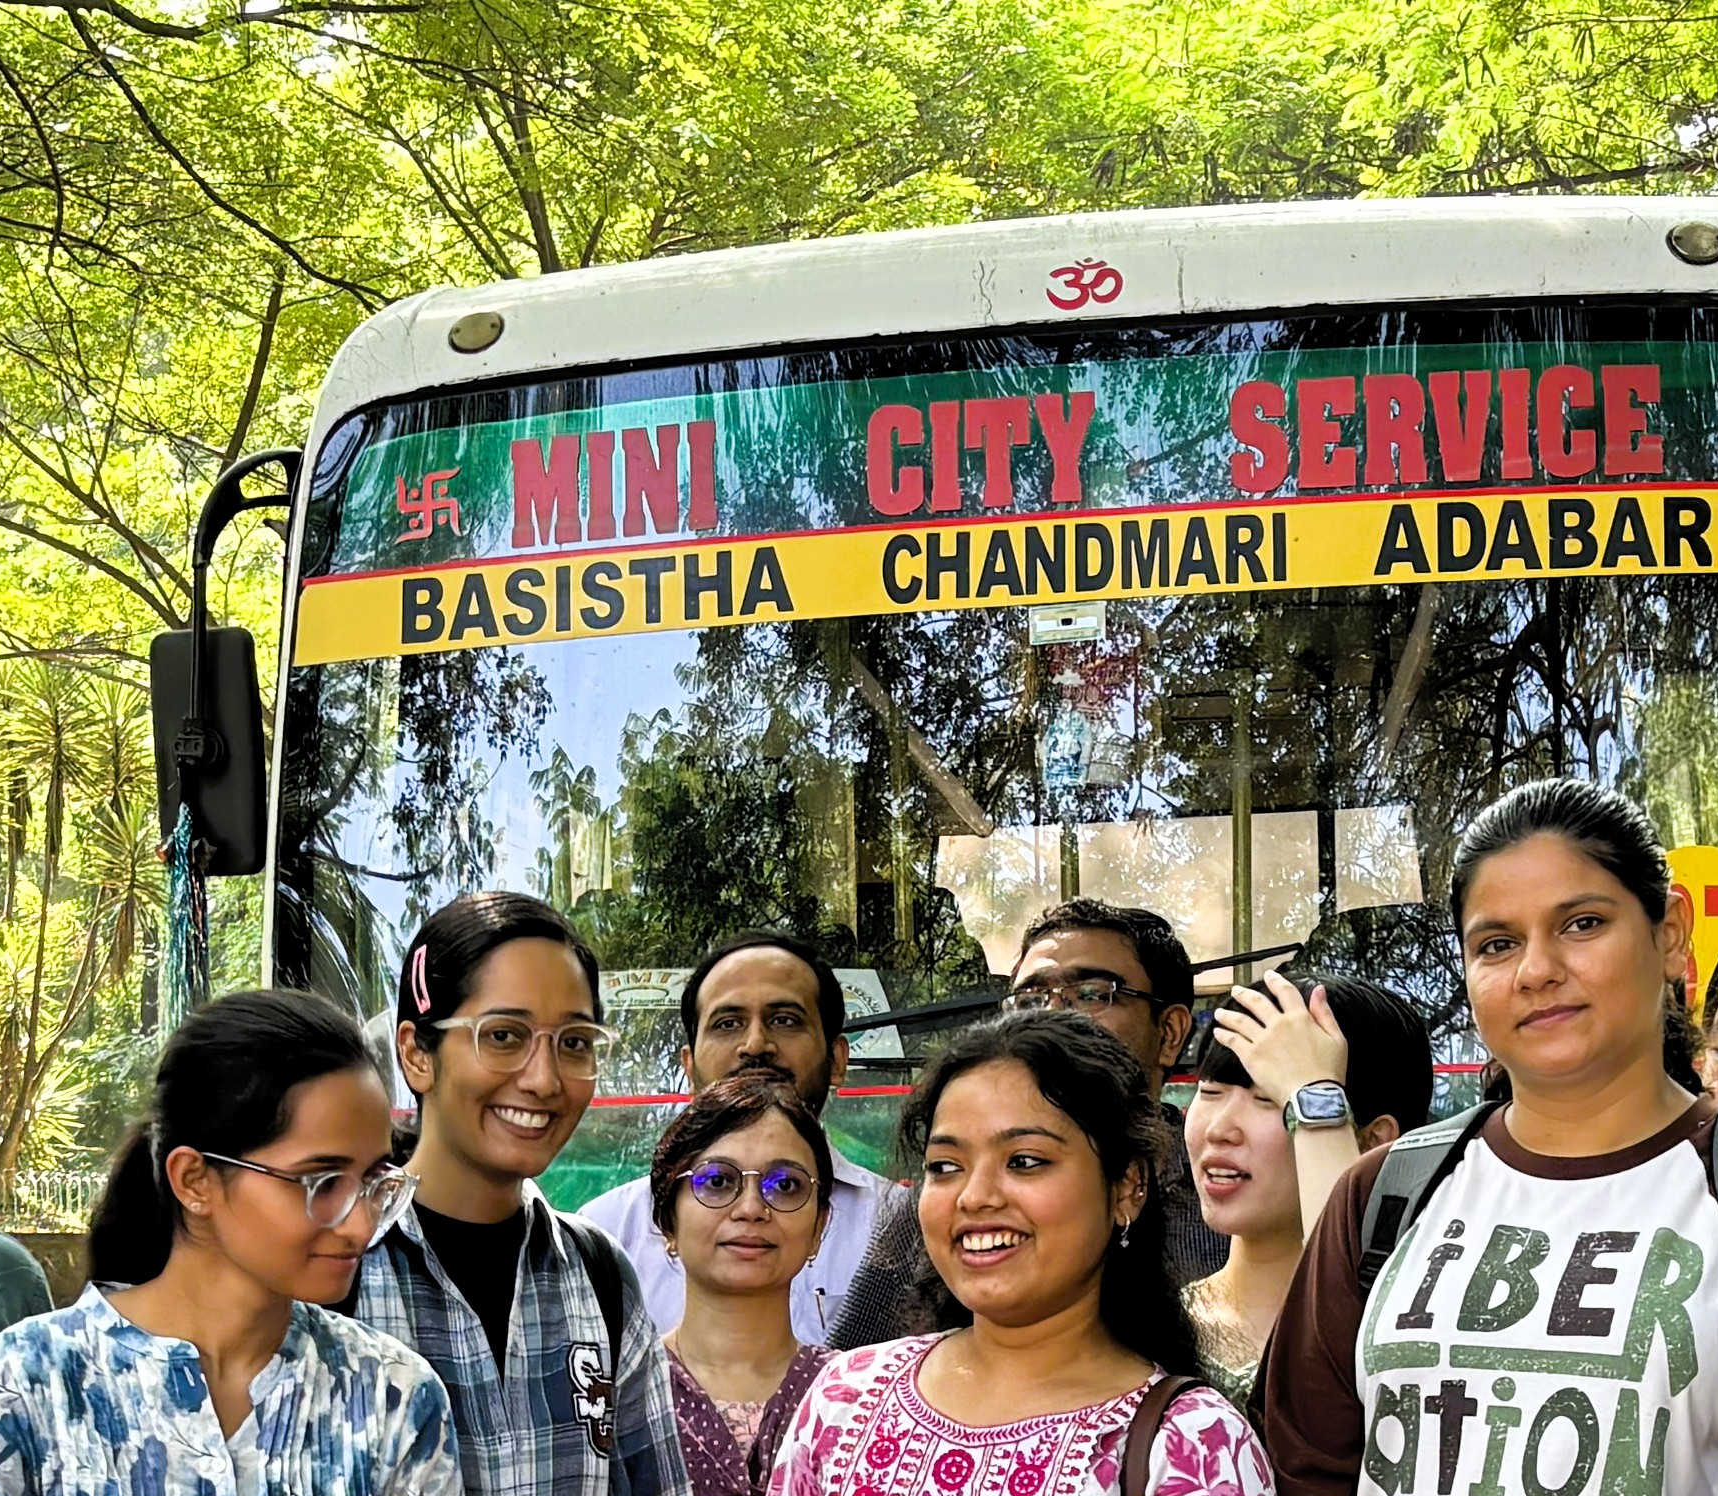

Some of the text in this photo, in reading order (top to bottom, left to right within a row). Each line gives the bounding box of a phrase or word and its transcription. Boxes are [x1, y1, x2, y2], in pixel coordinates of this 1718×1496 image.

[510, 364, 1664, 549] MINI CITY SERVICE
[401, 546, 794, 645] BASISTHA
[882, 513, 1287, 602] CHANDMARI
